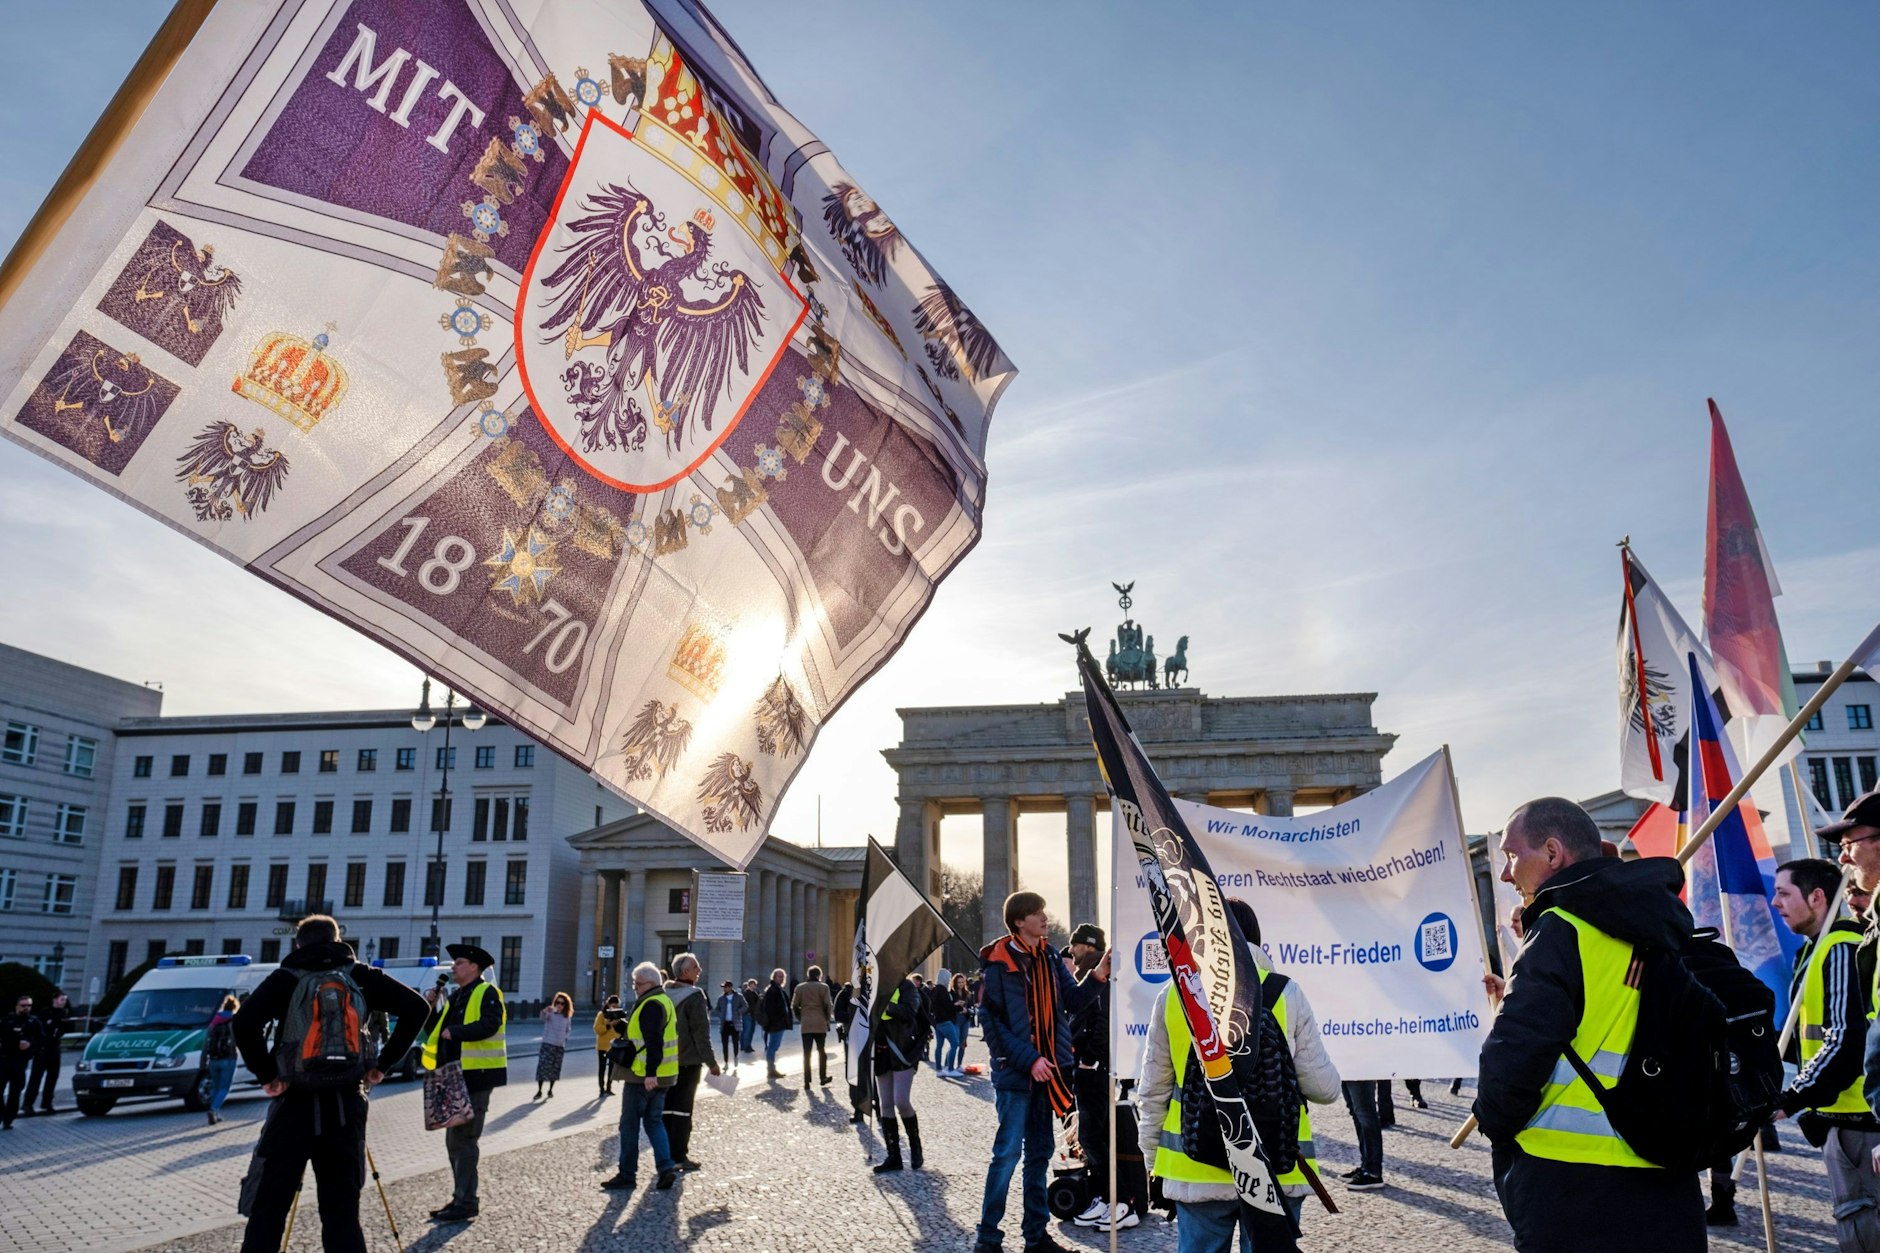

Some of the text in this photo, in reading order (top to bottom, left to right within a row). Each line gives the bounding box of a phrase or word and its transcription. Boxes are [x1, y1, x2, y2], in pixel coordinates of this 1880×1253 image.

[325, 22, 486, 155] MIT
[821, 431, 925, 556] UNS
[1207, 818, 1361, 843] Wir Monarchisten
[1215, 840, 1446, 889] eren Rechtstaat wiederhaben!
[184, 958, 217, 966] POLIZEI
[1279, 941, 1402, 965] Welt-Frieden
[106, 1039, 158, 1049] POLIZEI
